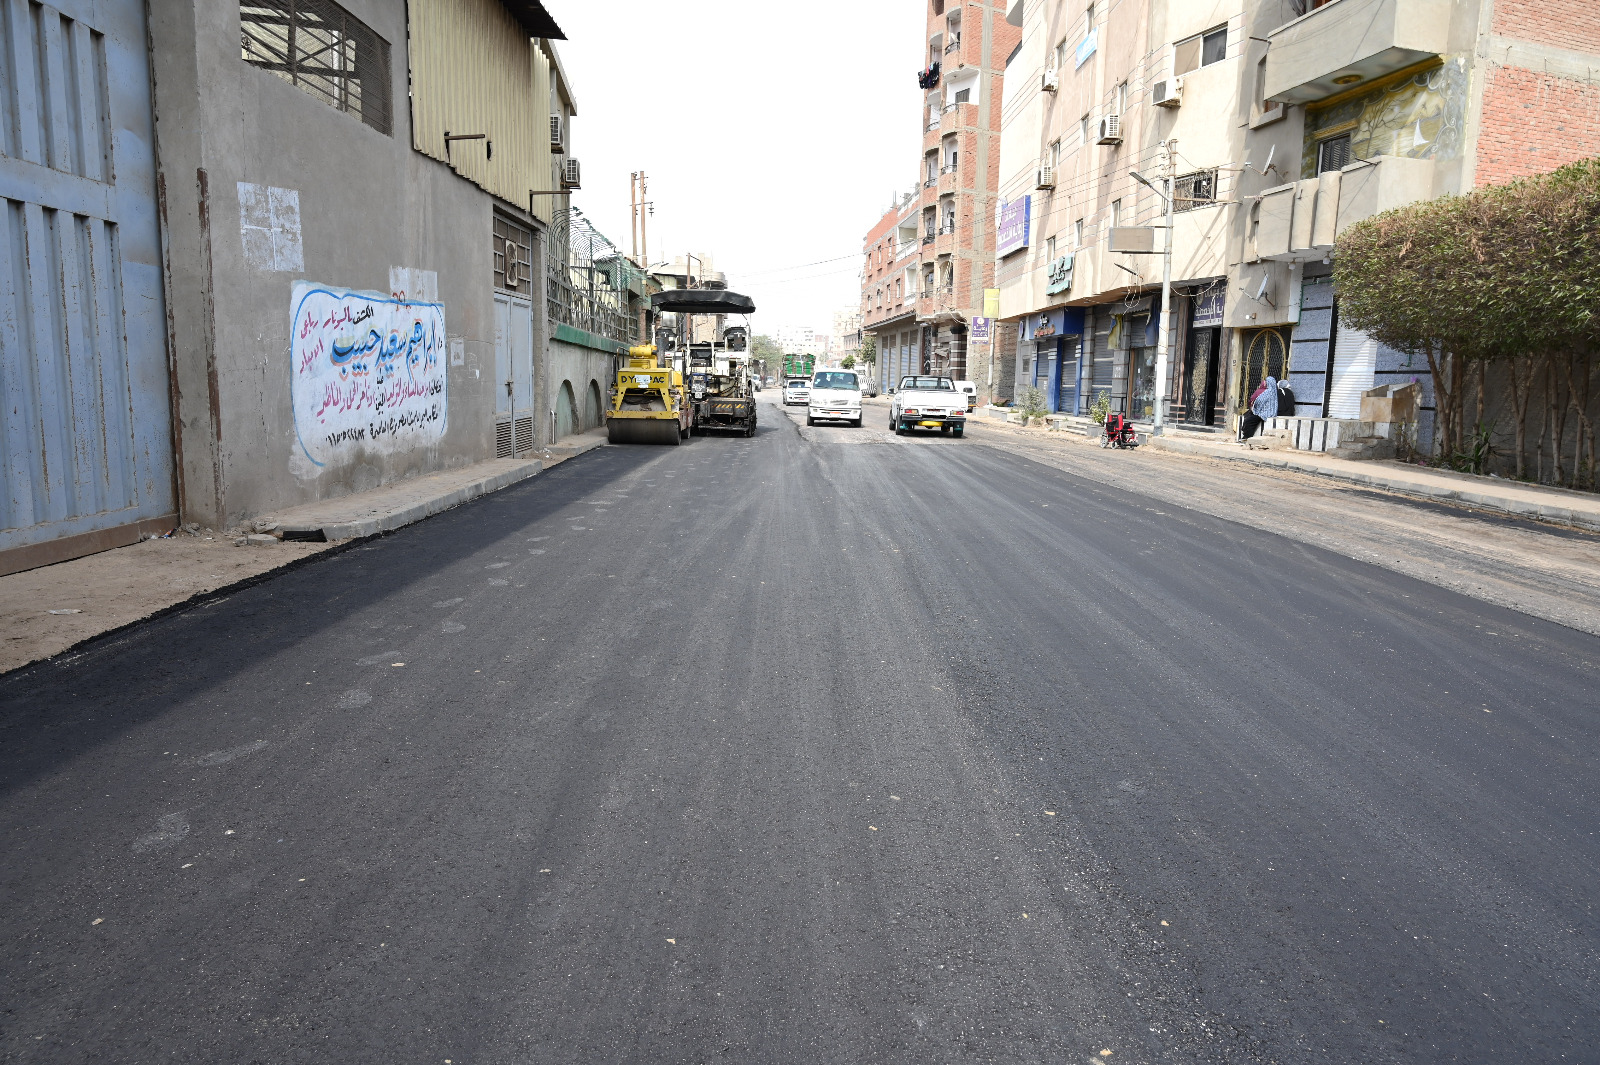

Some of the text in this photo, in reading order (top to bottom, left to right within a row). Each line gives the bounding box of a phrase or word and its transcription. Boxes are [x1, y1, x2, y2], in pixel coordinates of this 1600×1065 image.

[330, 328, 381, 381] حبيب
[375, 330, 407, 378] سعيد
[621, 375, 665, 384] DYAC
